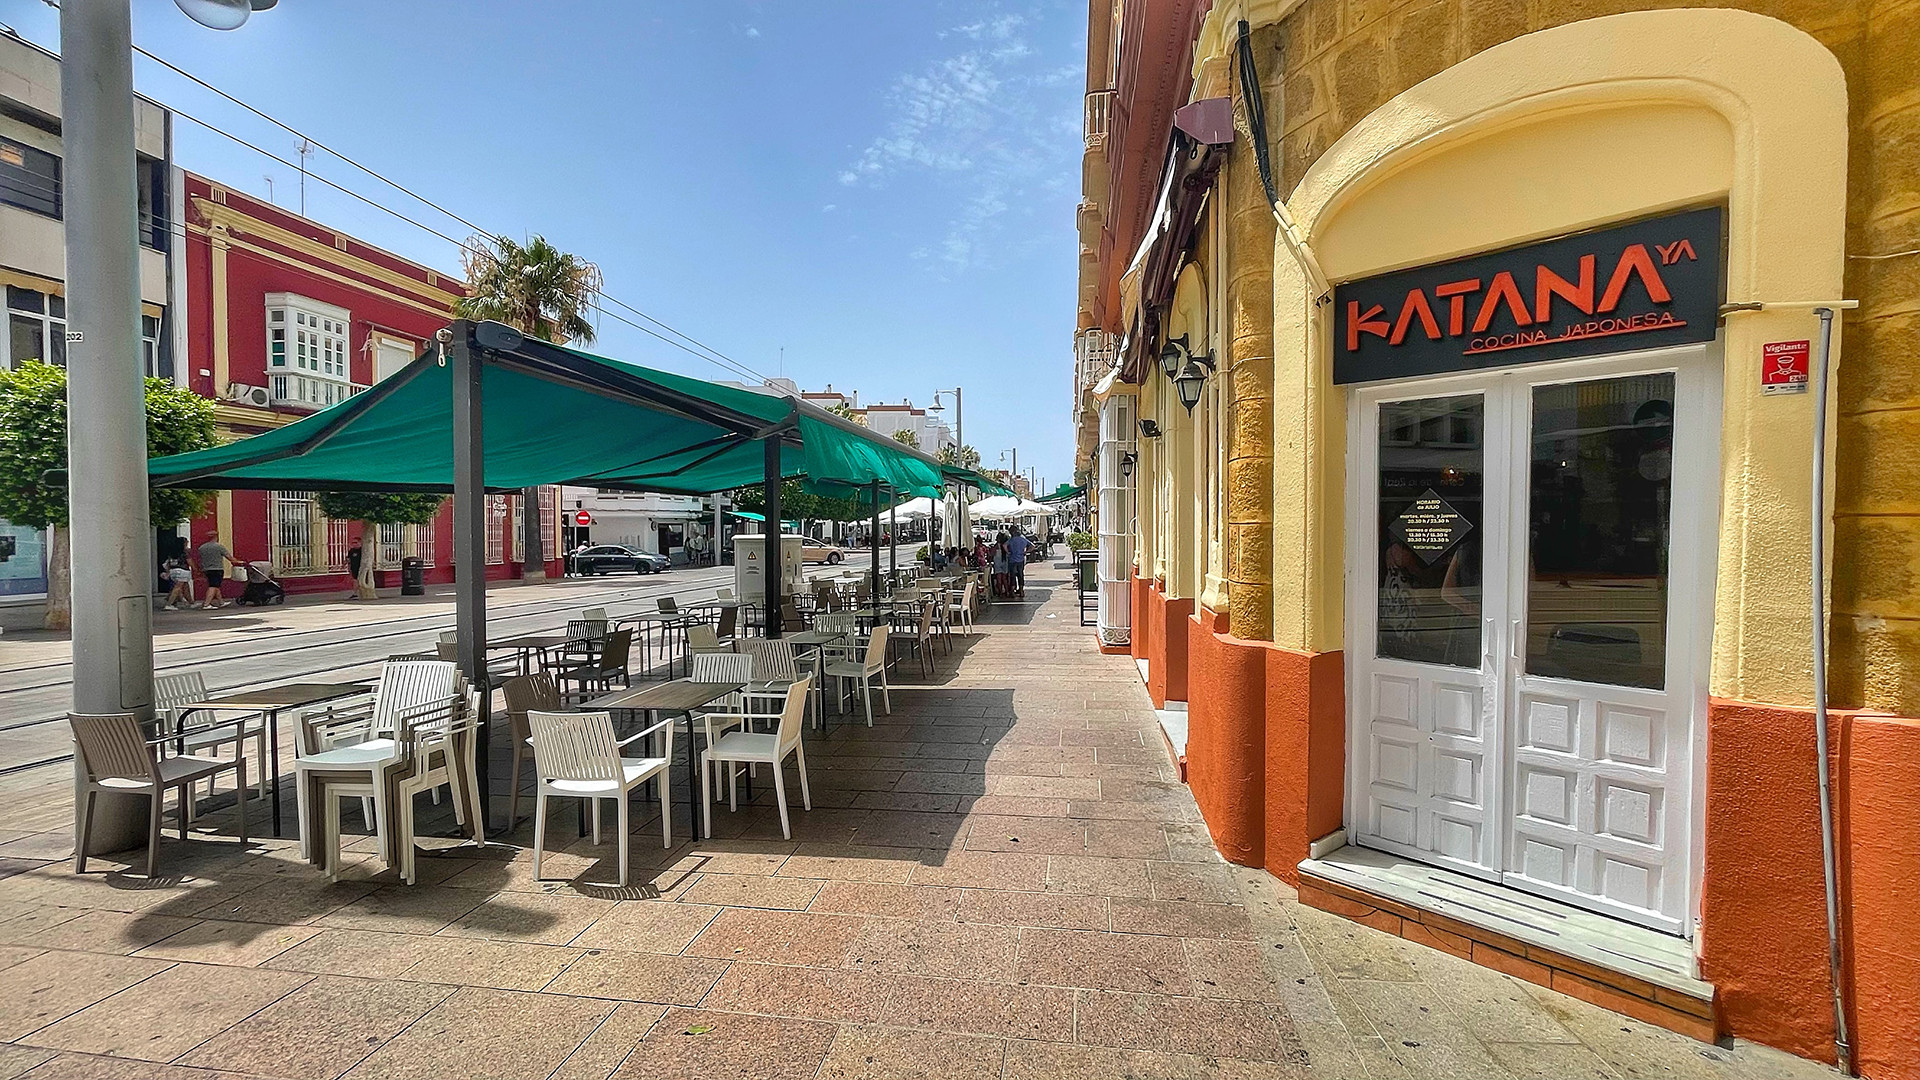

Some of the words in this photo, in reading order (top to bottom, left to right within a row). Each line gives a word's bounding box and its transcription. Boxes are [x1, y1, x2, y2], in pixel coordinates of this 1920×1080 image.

[1654, 238, 1698, 266] YA
[1347, 243, 1673, 351] KATANA
[1470, 329, 1548, 351] COCINA
[1559, 311, 1675, 339] JAPONESA
[1765, 343, 1808, 354] Vigilante
